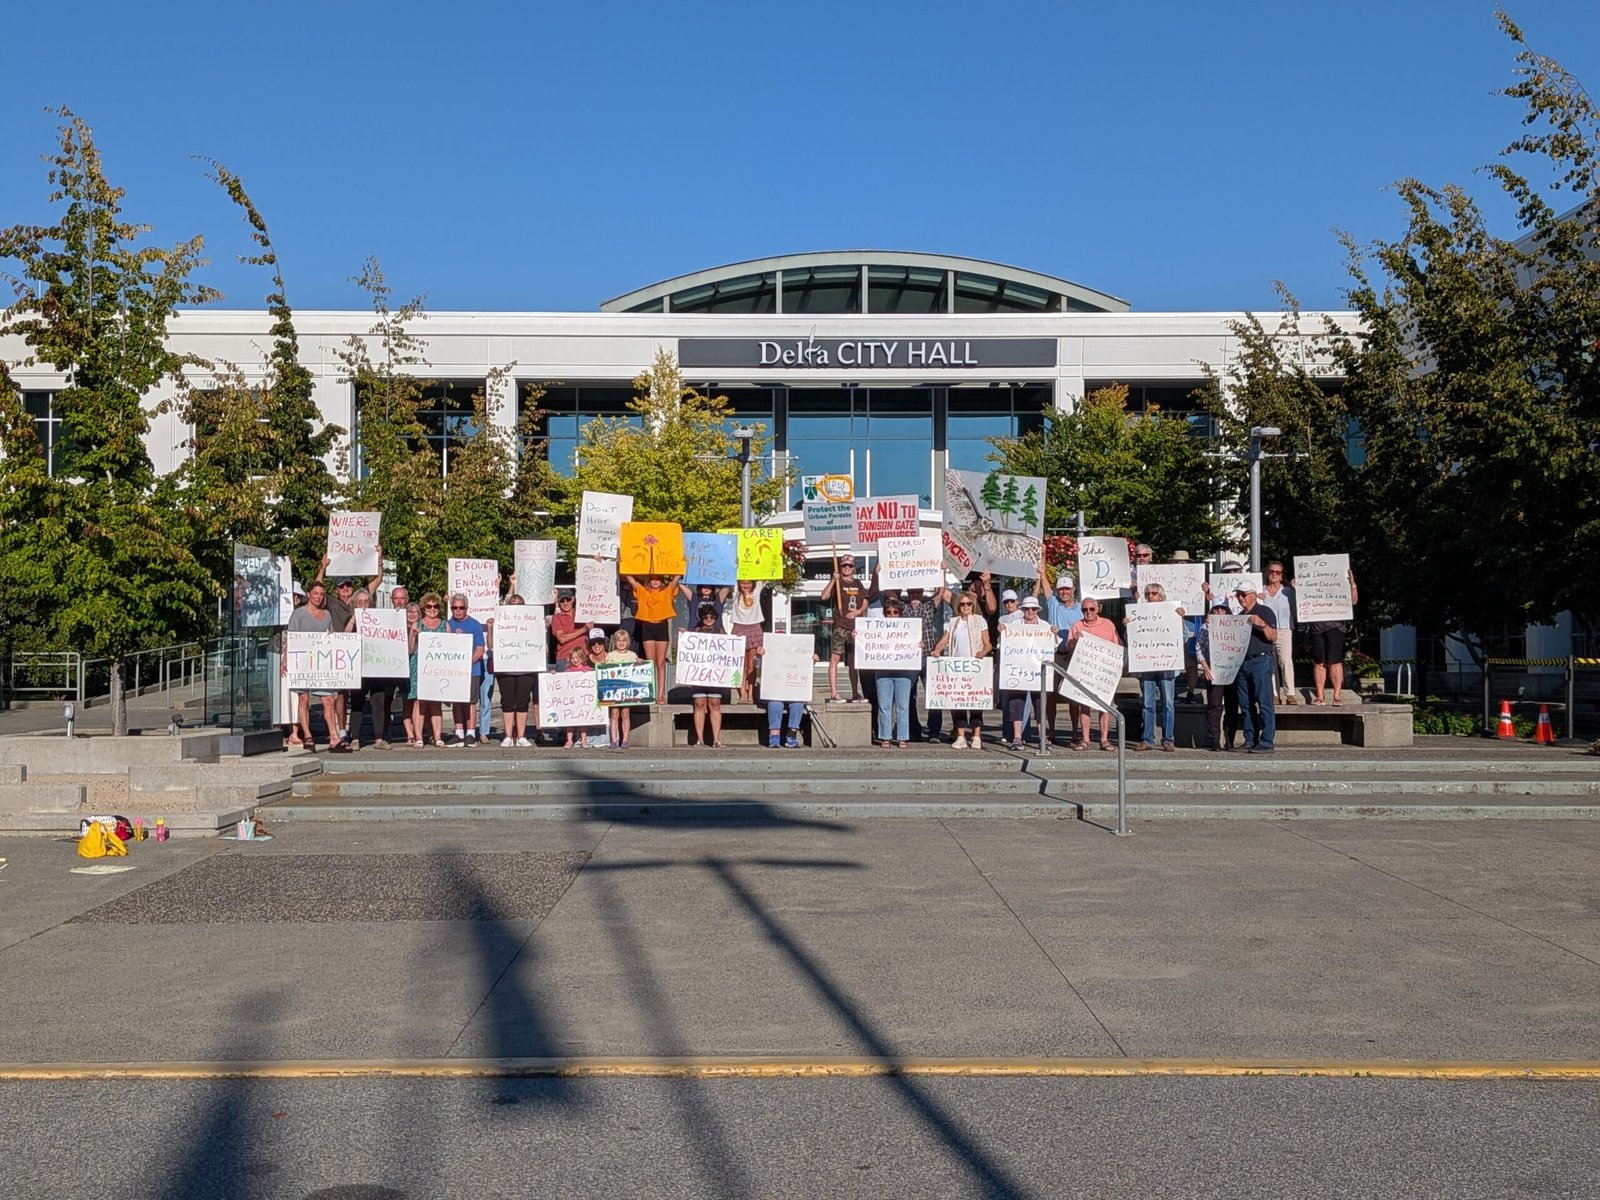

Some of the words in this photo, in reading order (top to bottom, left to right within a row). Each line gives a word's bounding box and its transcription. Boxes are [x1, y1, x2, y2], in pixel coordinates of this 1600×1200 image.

[759, 330, 829, 366] Delta
[837, 341, 898, 366] CITY
[907, 341, 978, 366] HALL
[877, 501, 898, 519] NO
[900, 505, 916, 519] TO
[331, 516, 371, 527] WHERE
[857, 520, 893, 531] ENNISON
[895, 520, 915, 530] GATE
[331, 529, 358, 539] WILL
[331, 541, 365, 555] PARK
[517, 542, 553, 552] STOP
[1083, 543, 1106, 556] The
[901, 550, 916, 558] NOT
[454, 561, 495, 571] ENOUGH
[588, 594, 604, 603] NOT
[361, 611, 381, 626] Be
[1219, 619, 1232, 627] NO
[1233, 619, 1245, 627] TO
[864, 620, 872, 630] T
[875, 620, 900, 629] TOWN
[903, 621, 911, 630] IS
[307, 632, 322, 640] NOT
[864, 632, 883, 640] OUR
[886, 632, 910, 640] HOME
[1211, 631, 1237, 641] HIGH
[428, 636, 442, 648] Is
[684, 634, 743, 651] SMART
[864, 642, 891, 651] BRING
[894, 642, 913, 651] BACK
[363, 643, 382, 654] ESS
[1004, 646, 1025, 656] Once
[678, 650, 744, 667] DEVELOPMENT
[864, 652, 893, 661] PUBLIC
[931, 659, 982, 674] TREES
[344, 673, 355, 681] IN
[600, 669, 629, 680] MORE
[631, 668, 653, 677] PARKS
[684, 664, 728, 684] PLEASE
[936, 674, 959, 682] filter
[439, 678, 450, 699] ?
[545, 679, 563, 691] WE
[566, 678, 595, 689] NEED
[603, 689, 620, 698] FOR
[624, 687, 649, 698] KIDS
[934, 690, 966, 698] improve
[545, 696, 576, 708] SPACE
[580, 694, 595, 706] TO
[929, 699, 946, 707] ALL
[563, 708, 595, 720] PLAY!
